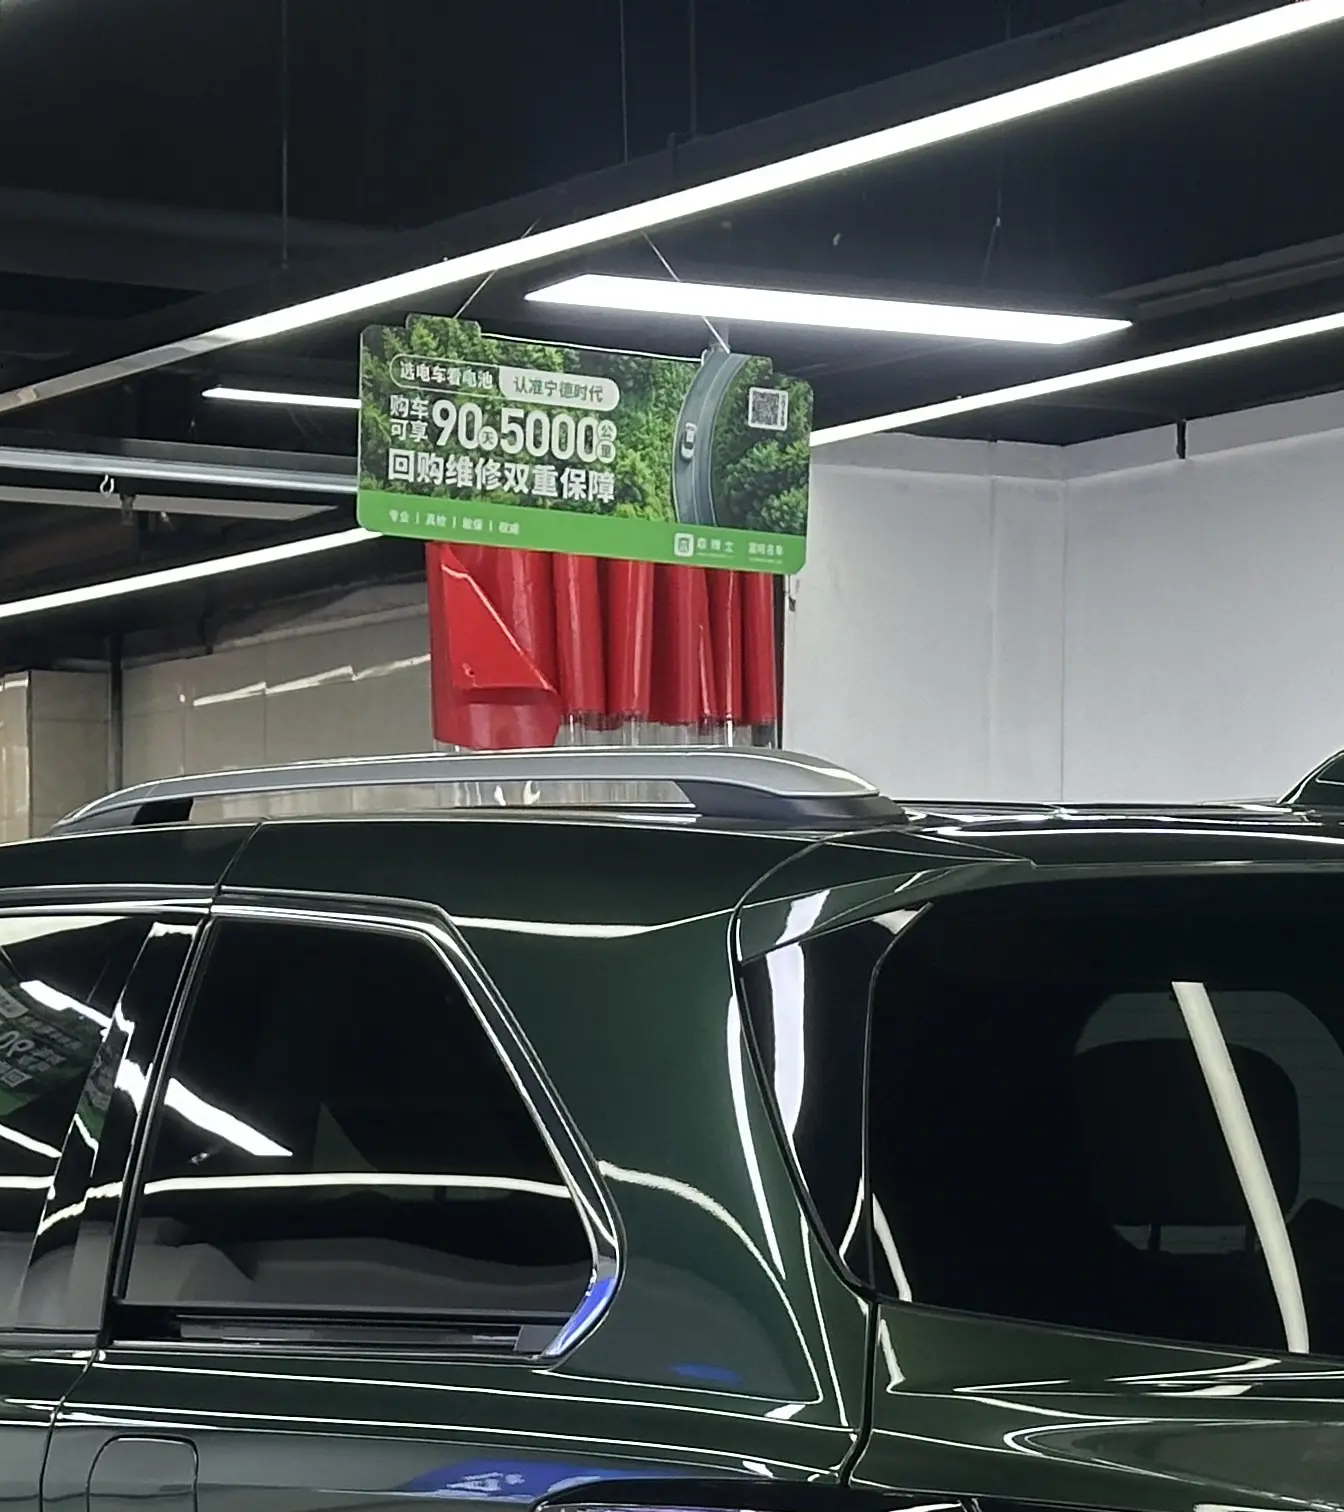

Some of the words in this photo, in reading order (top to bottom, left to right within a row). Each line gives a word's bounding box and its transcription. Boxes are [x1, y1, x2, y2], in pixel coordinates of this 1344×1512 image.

[400, 360, 493, 389] 选电车看电池
[513, 375, 603, 402] 认准宁德时代
[390, 394, 430, 419] 购车
[390, 417, 429, 443] 可享
[388, 448, 615, 503] 回购维修双重保障
